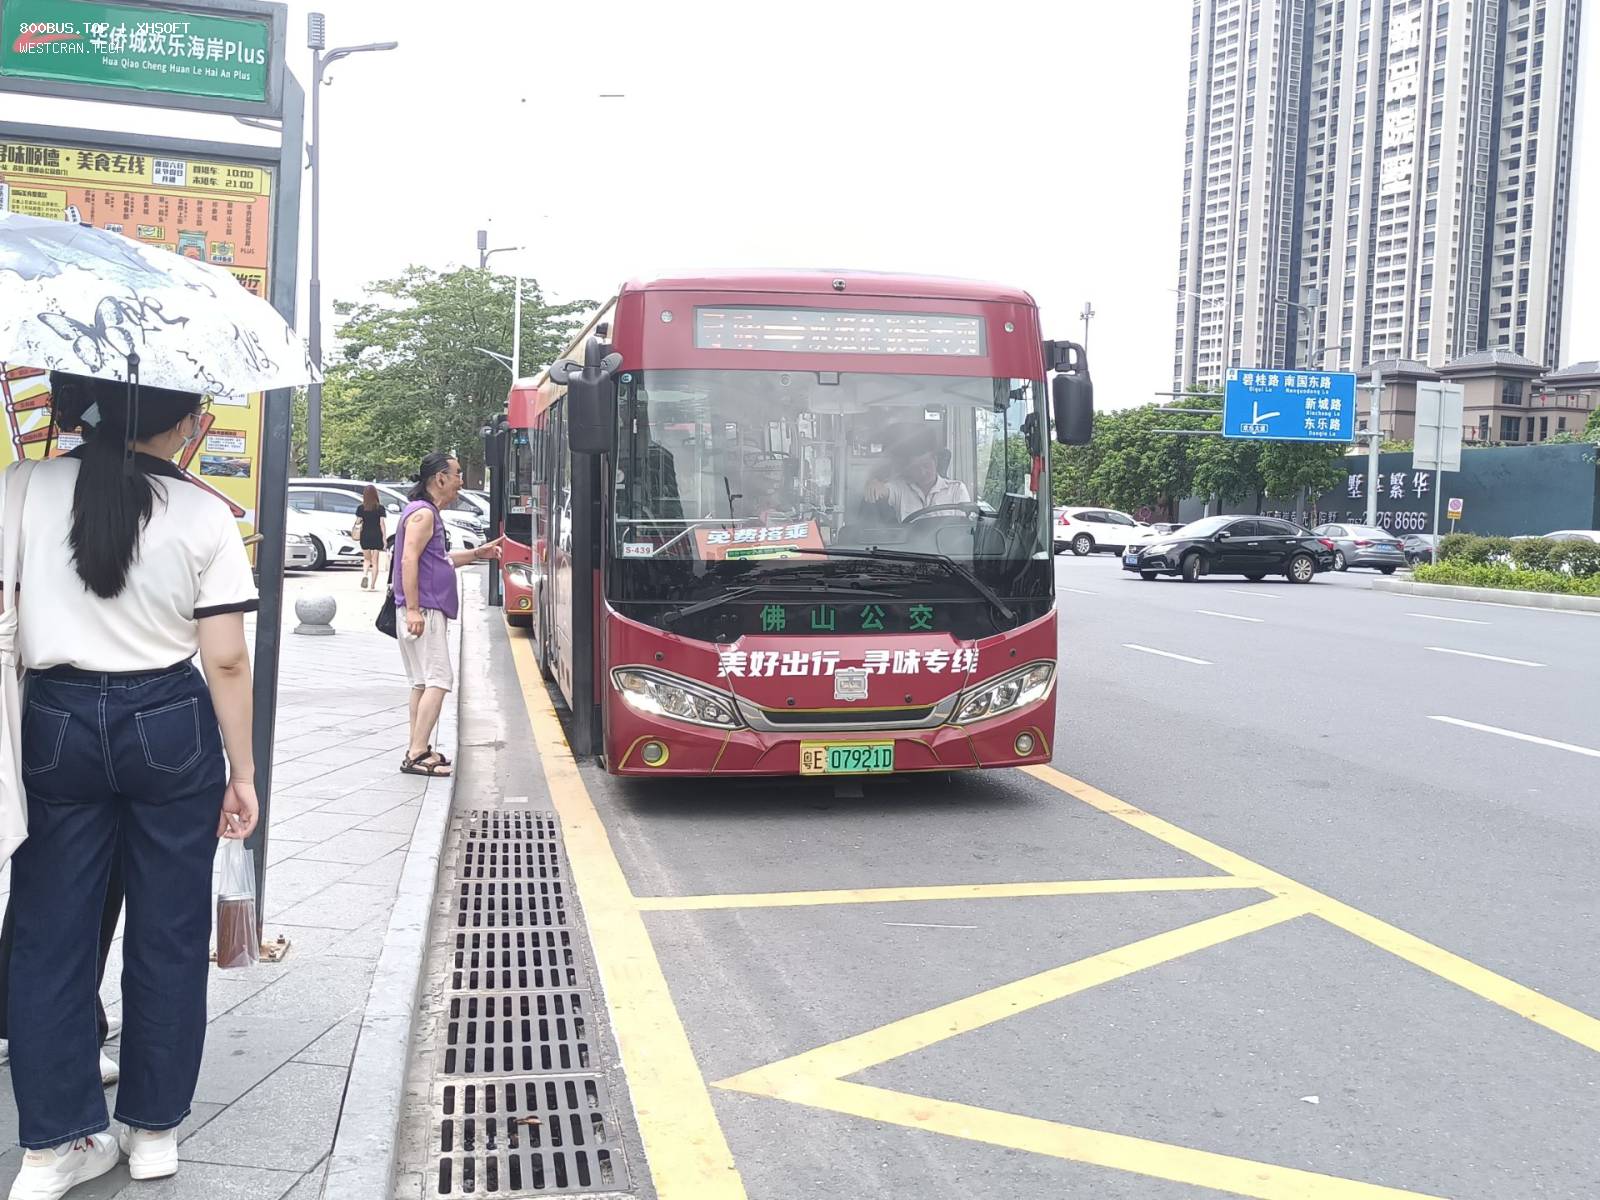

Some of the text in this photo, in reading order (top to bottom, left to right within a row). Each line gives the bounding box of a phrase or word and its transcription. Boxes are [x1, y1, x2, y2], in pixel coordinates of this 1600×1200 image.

[102, 56, 250, 80] Hua Qiao Cheng Huan Le Hai An Plus
[1243, 374, 1331, 389] 碧桂路 南国东路
[1305, 398, 1341, 411] 新城路
[1304, 418, 1340, 431] 东乐路
[1394, 511, 1426, 530] 8666
[707, 523, 809, 545] 免费搭乘
[760, 604, 935, 631] 佛山公交
[716, 648, 980, 678] 美好出行 寻味专线
[803, 749, 893, 770] 粤E 07921D
